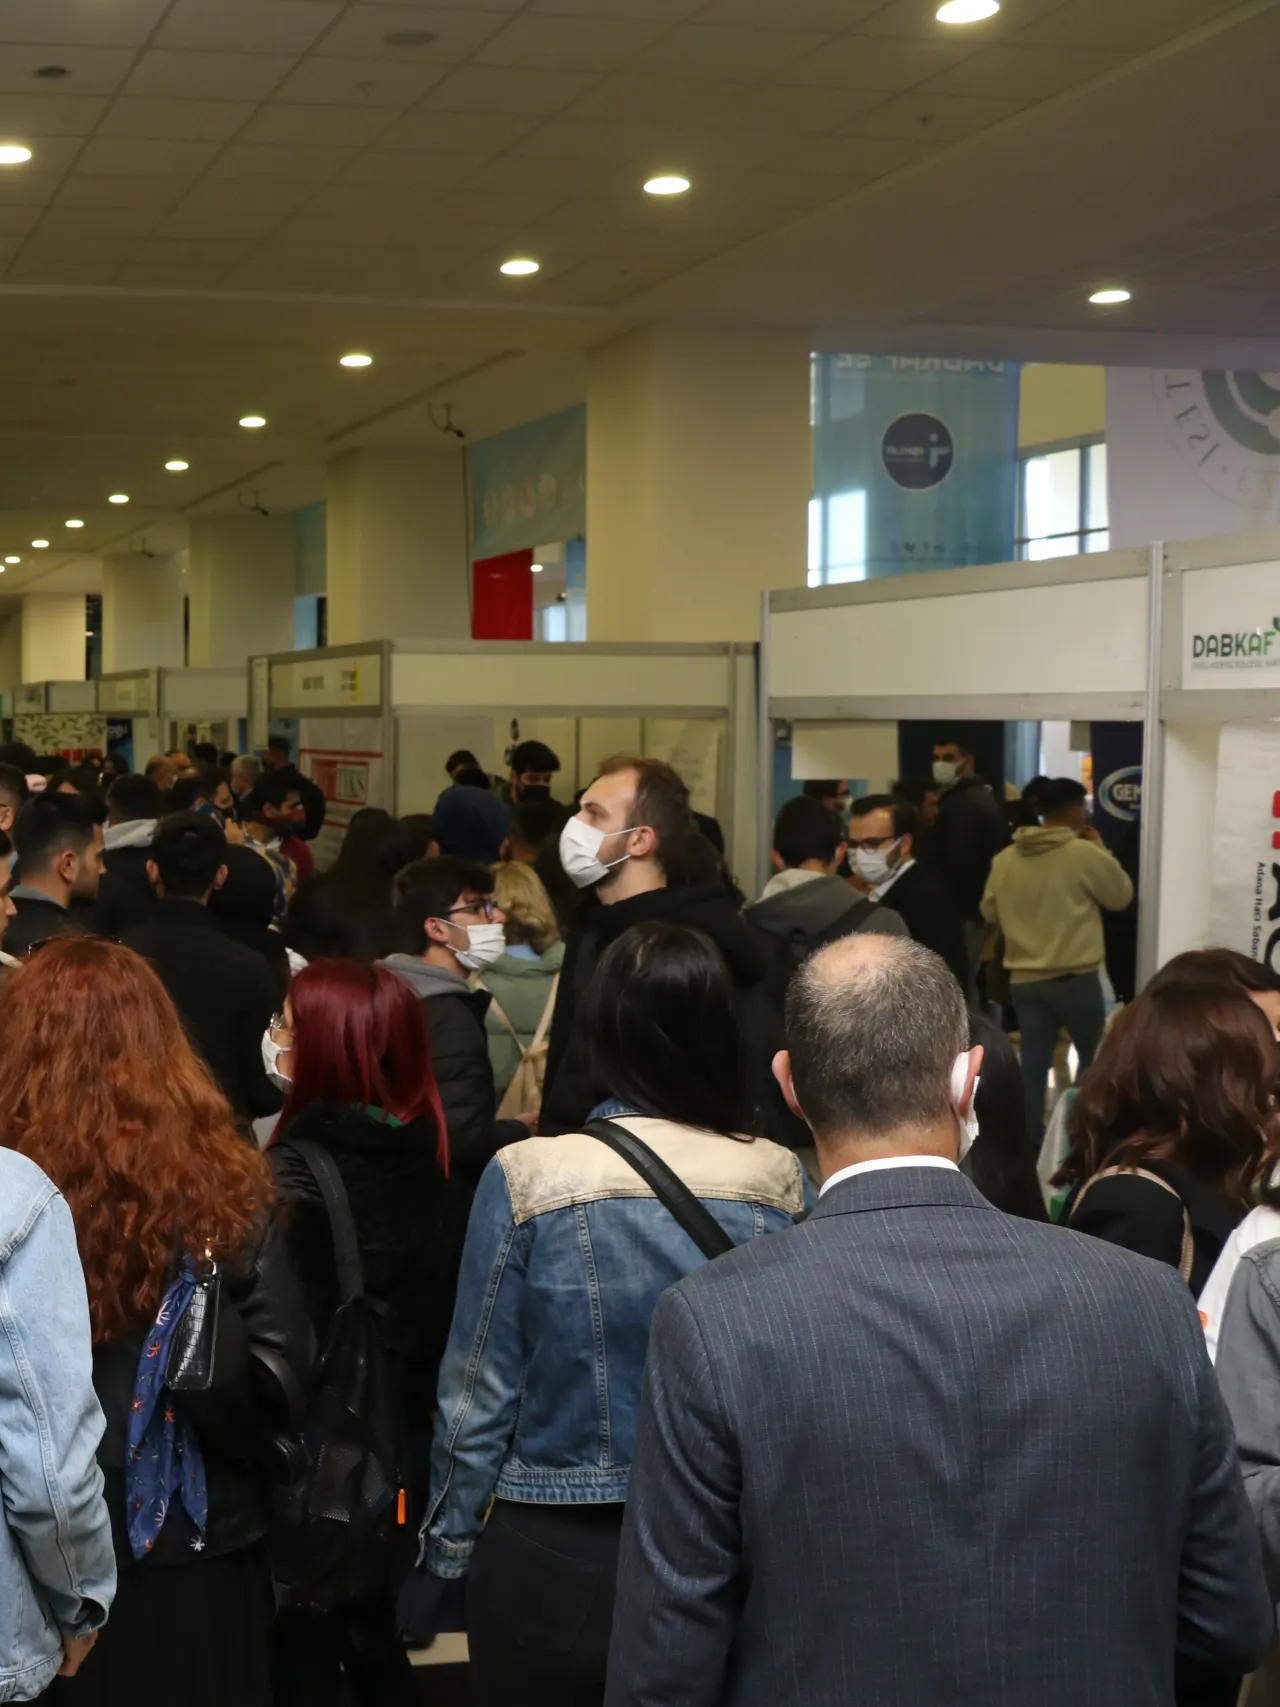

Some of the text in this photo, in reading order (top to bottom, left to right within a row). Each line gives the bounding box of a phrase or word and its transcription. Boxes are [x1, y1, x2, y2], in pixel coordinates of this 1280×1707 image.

[1193, 631, 1277, 658] DABKAF
[1255, 862, 1266, 895] Adana
[1251, 925, 1263, 959] Saban
